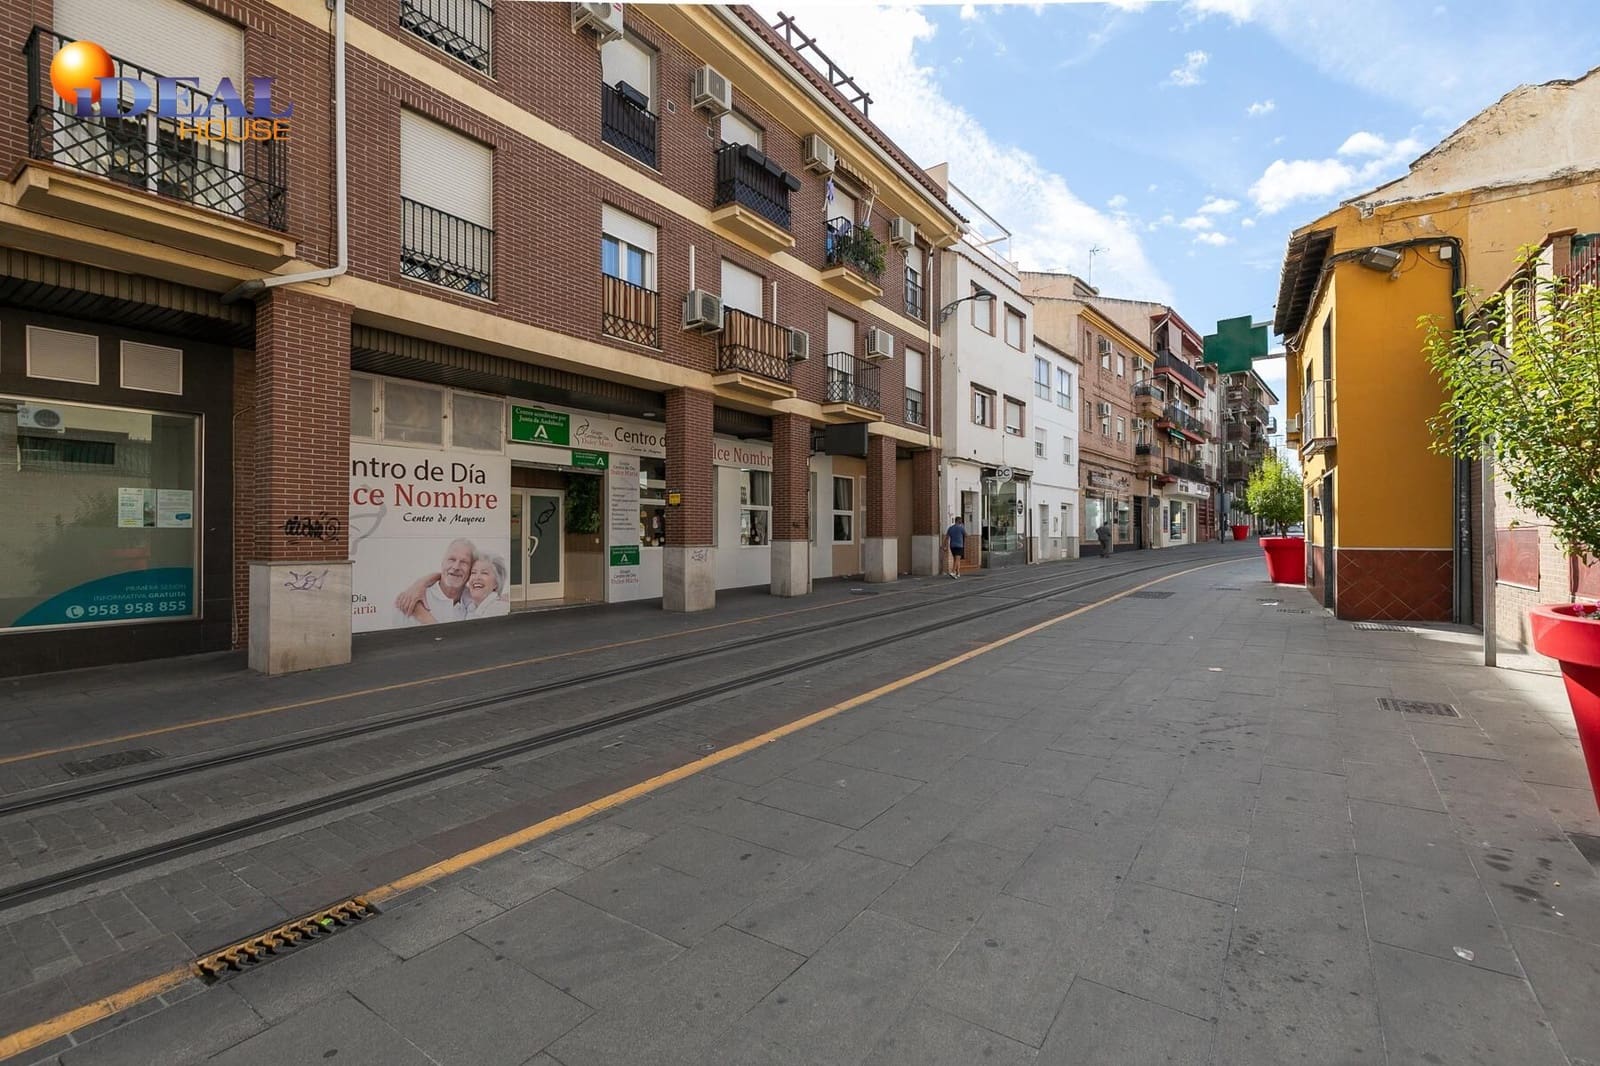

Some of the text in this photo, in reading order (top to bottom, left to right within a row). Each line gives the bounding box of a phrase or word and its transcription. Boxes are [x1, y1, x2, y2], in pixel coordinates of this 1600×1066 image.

[614, 426, 657, 446] Centro
[352, 458, 486, 484] ntro de Día
[997, 468, 1010, 477] DC
[393, 483, 498, 509] Nombre
[402, 513, 486, 526] Centro de Mayores
[148, 591, 186, 599] GRATUITA
[88, 600, 186, 617] 958 958 855
